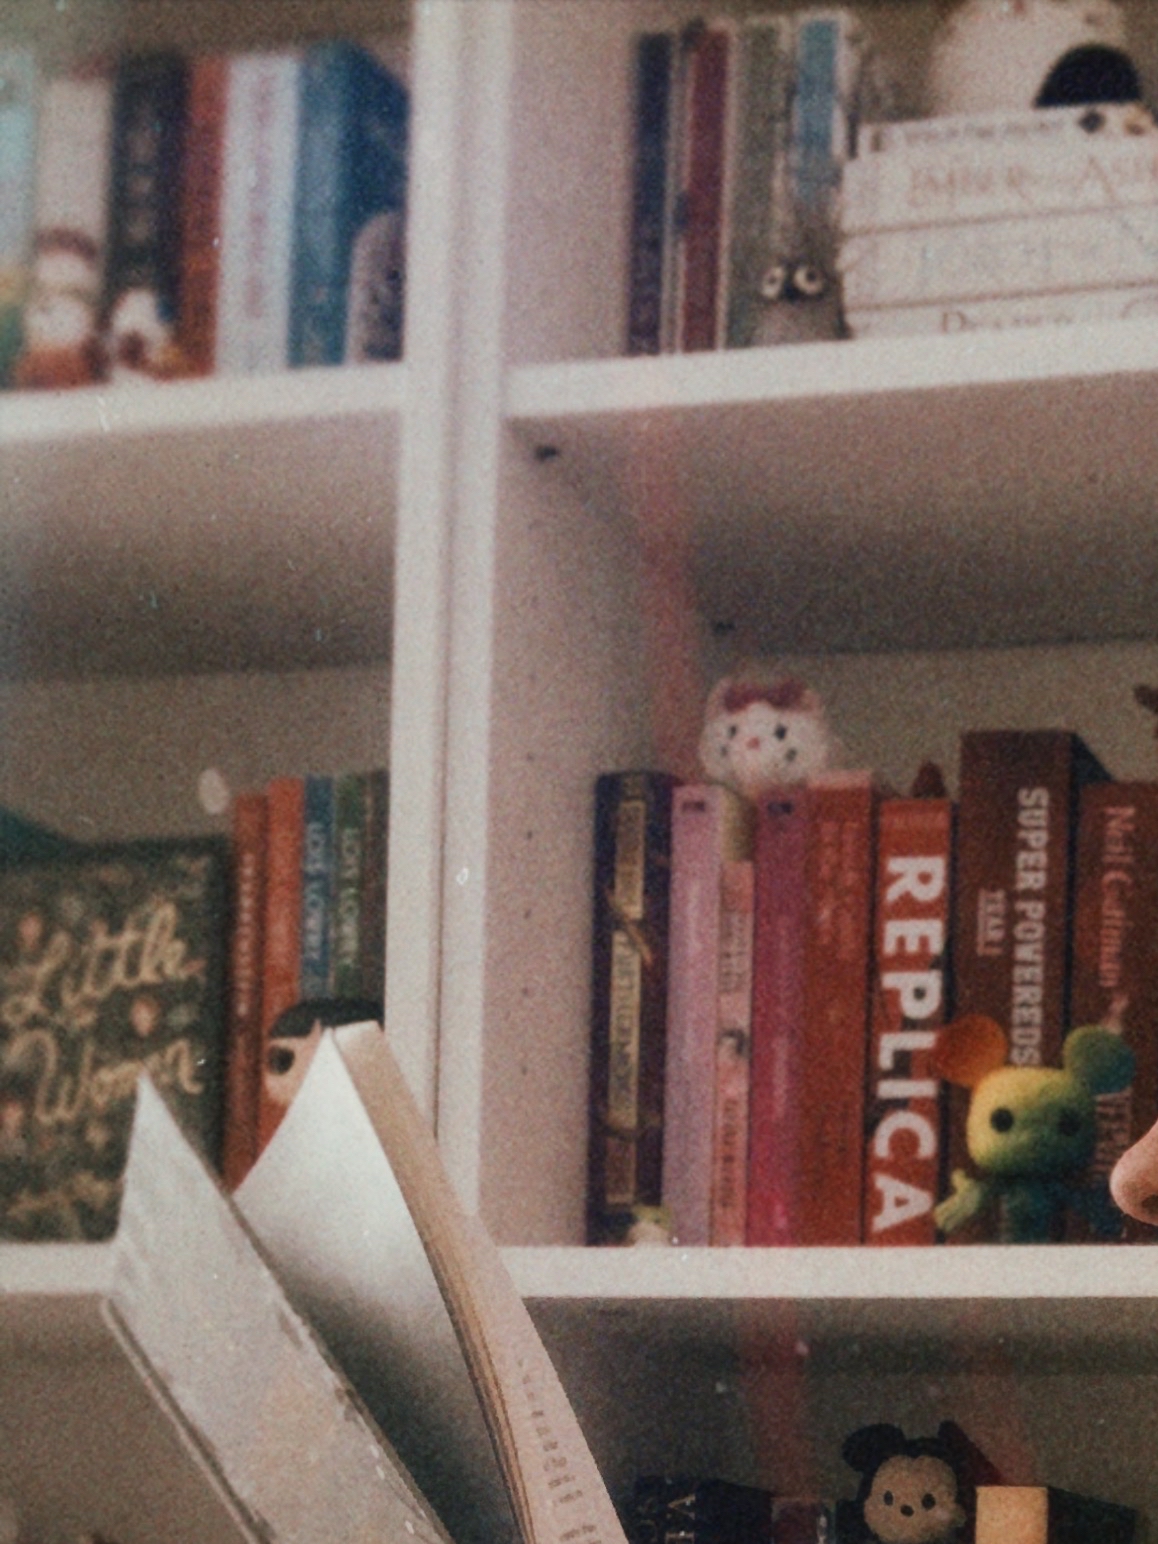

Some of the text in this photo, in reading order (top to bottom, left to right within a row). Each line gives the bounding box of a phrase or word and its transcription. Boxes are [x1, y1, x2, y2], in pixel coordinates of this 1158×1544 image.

[307, 822, 326, 872] LOIS
[341, 827, 359, 879] LOIS
[1099, 805, 1136, 988] Neil Gaiman
[983, 889, 1005, 941] YEAR
[1011, 787, 1049, 1066] SUPER POWEREDS
[873, 854, 944, 1232] REPLICA
